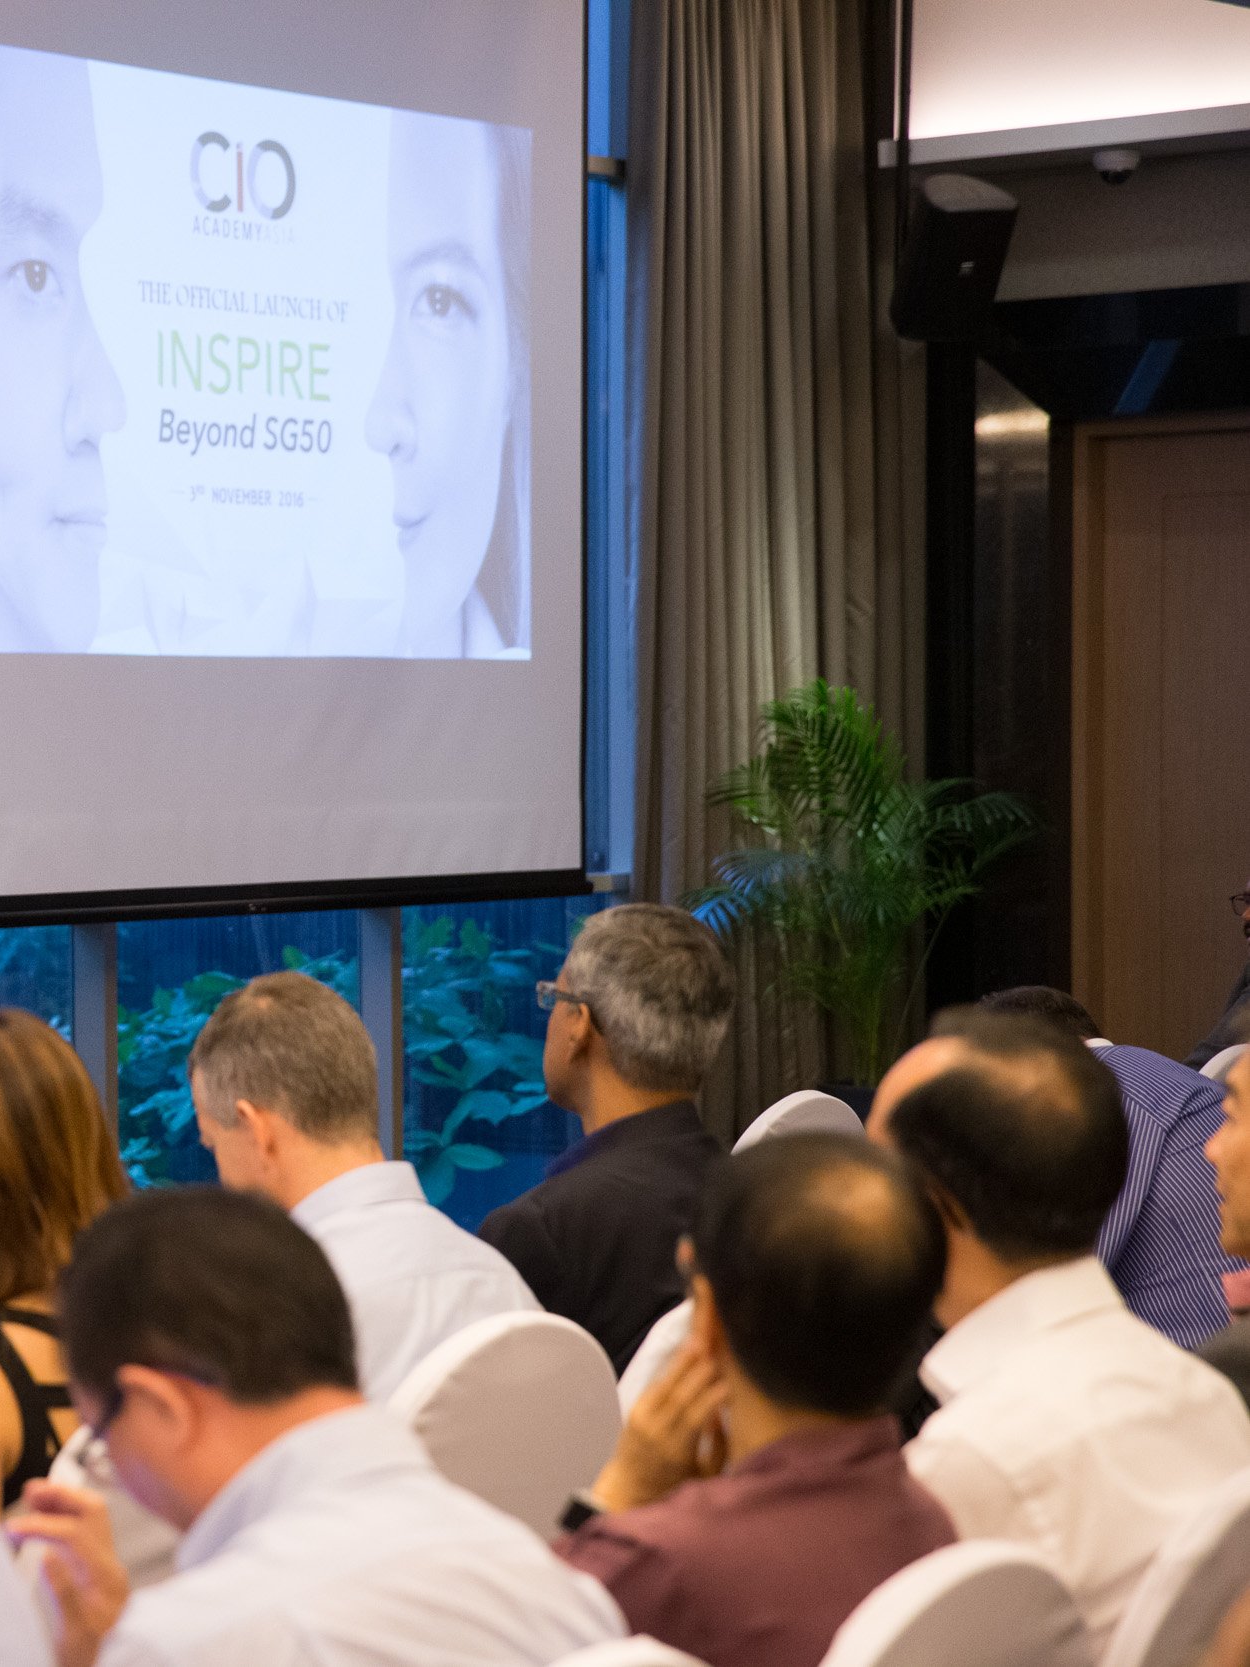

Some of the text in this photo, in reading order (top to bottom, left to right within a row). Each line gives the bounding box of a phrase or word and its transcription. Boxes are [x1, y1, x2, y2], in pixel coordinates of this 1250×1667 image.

[138, 280, 349, 323] THE OFFICIAL LAUNCH OF
[157, 329, 331, 402] INSPIRE
[159, 408, 332, 456] Beyond SG50
[211, 488, 273, 507] NOVEMBER
[278, 491, 304, 508] 2016
